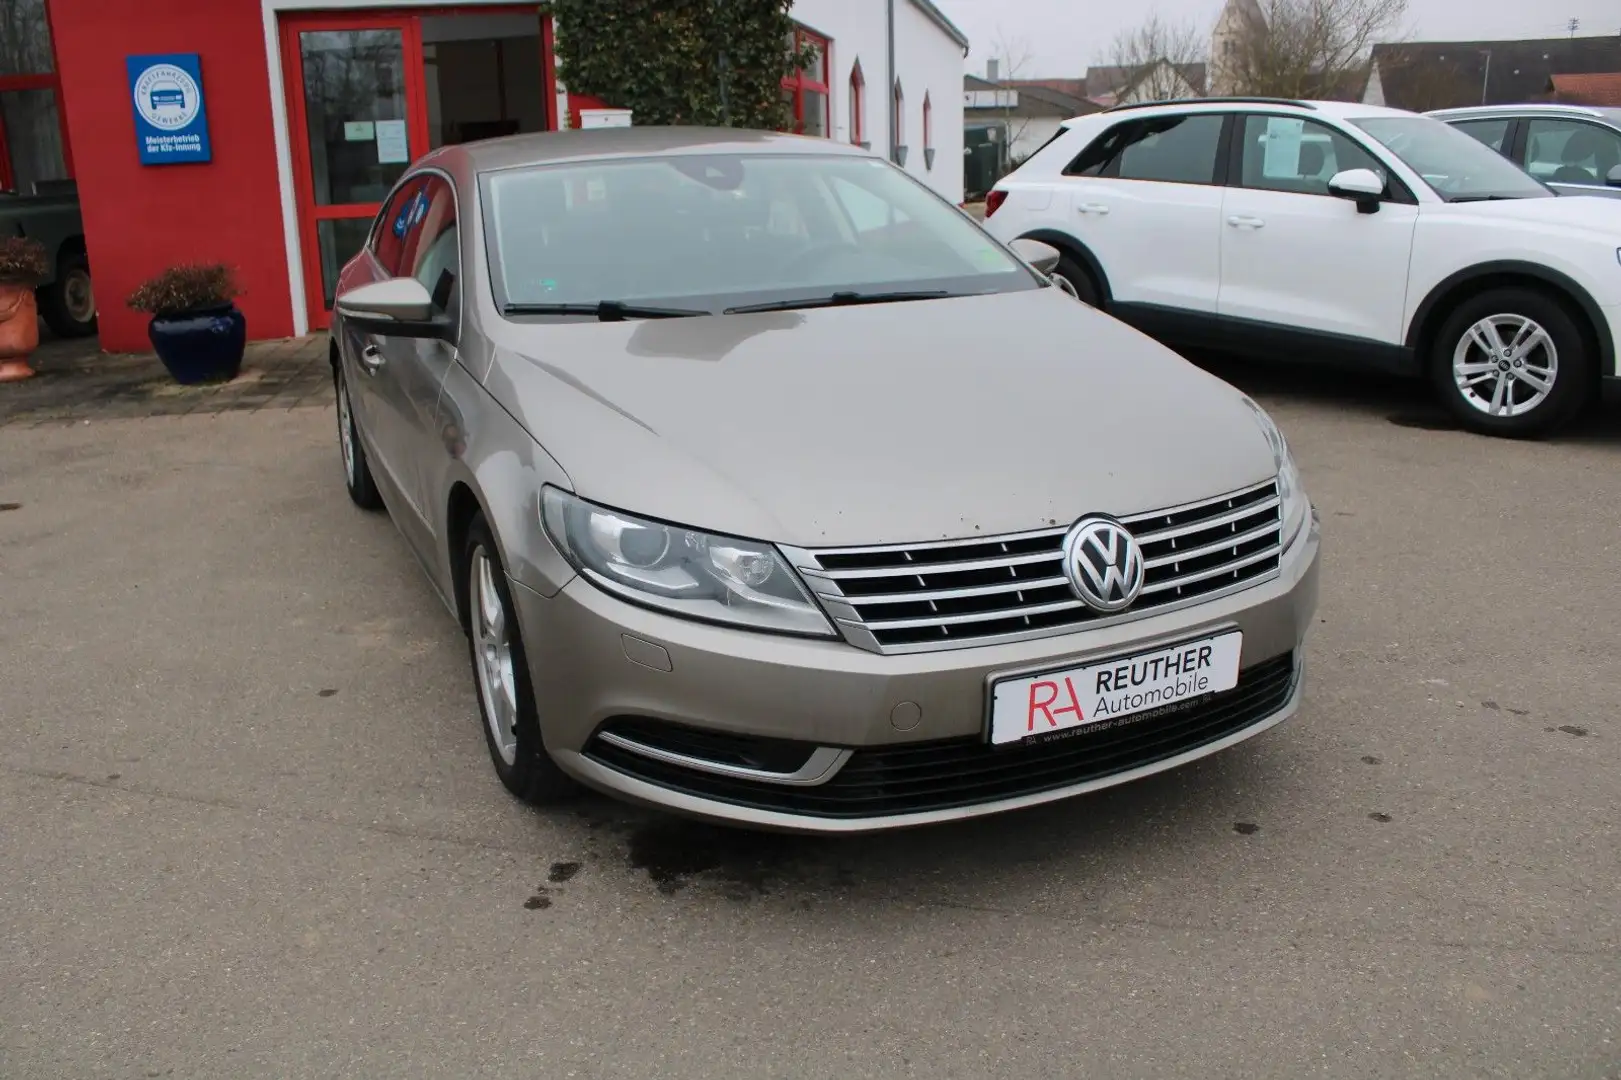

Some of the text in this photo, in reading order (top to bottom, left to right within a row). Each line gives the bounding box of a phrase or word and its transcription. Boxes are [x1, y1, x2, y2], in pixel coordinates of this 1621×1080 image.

[145, 134, 200, 144] Meisterbetrieb
[147, 142, 201, 153] der Kfz-Innung
[1095, 645, 1212, 694] REUTHER
[1027, 676, 1084, 732] RA
[1093, 672, 1209, 717] Automobile
[1043, 698, 1199, 743] www.reuther-automobile.com
